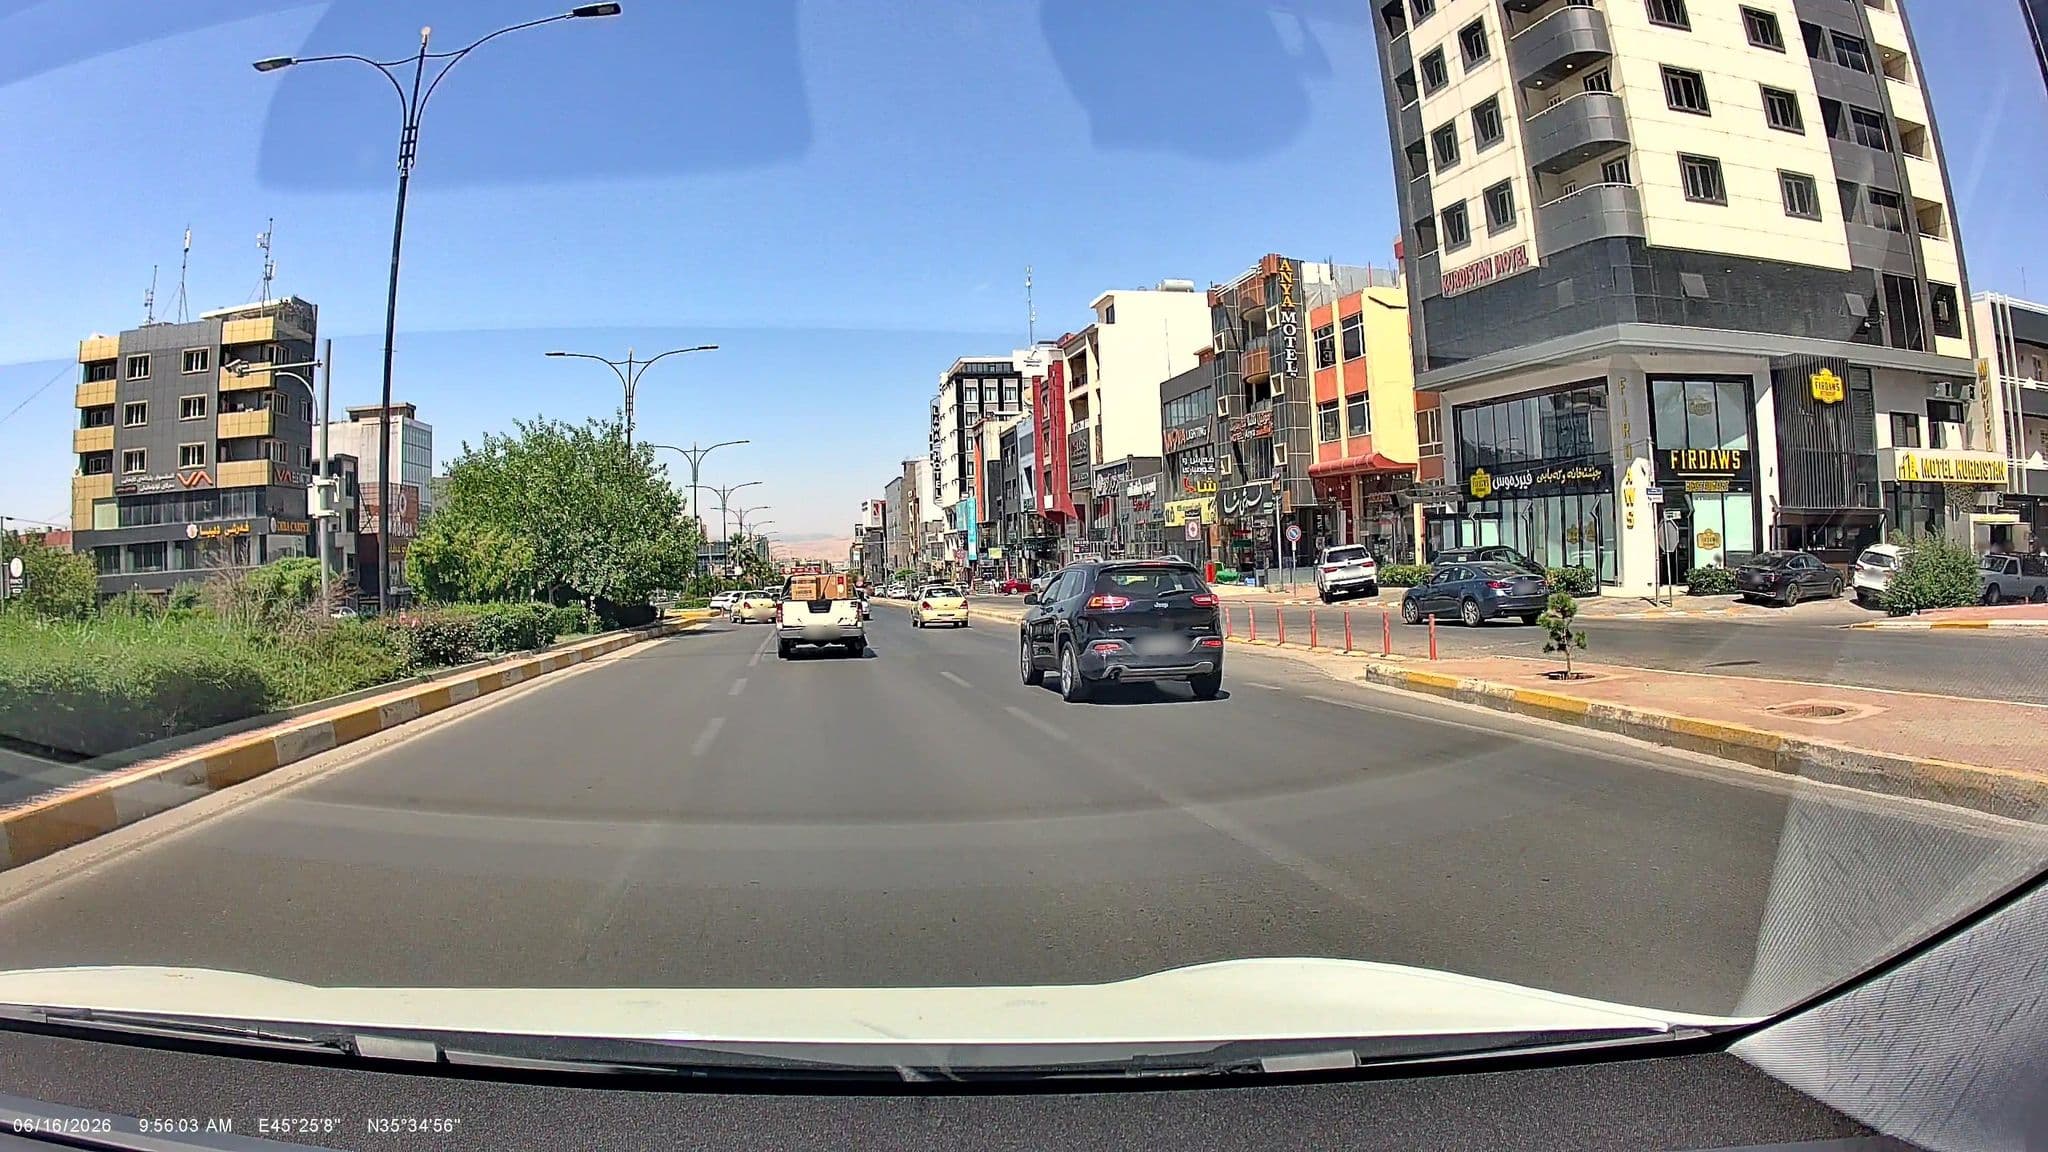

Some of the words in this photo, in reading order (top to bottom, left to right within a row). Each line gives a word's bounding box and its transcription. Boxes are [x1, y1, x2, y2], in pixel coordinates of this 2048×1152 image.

[1280, 259, 1296, 308] ANYA
[1442, 257, 1493, 295] KURDISTAN
[1494, 245, 1529, 276] MOTEL
[1281, 311, 1298, 373] MOTEL
[1618, 376, 1636, 530] FIRDAWS
[1670, 449, 1741, 470] FIRDAWS
[1921, 458, 1954, 480] MOTEL
[1955, 459, 2005, 481] KURDISTAN
